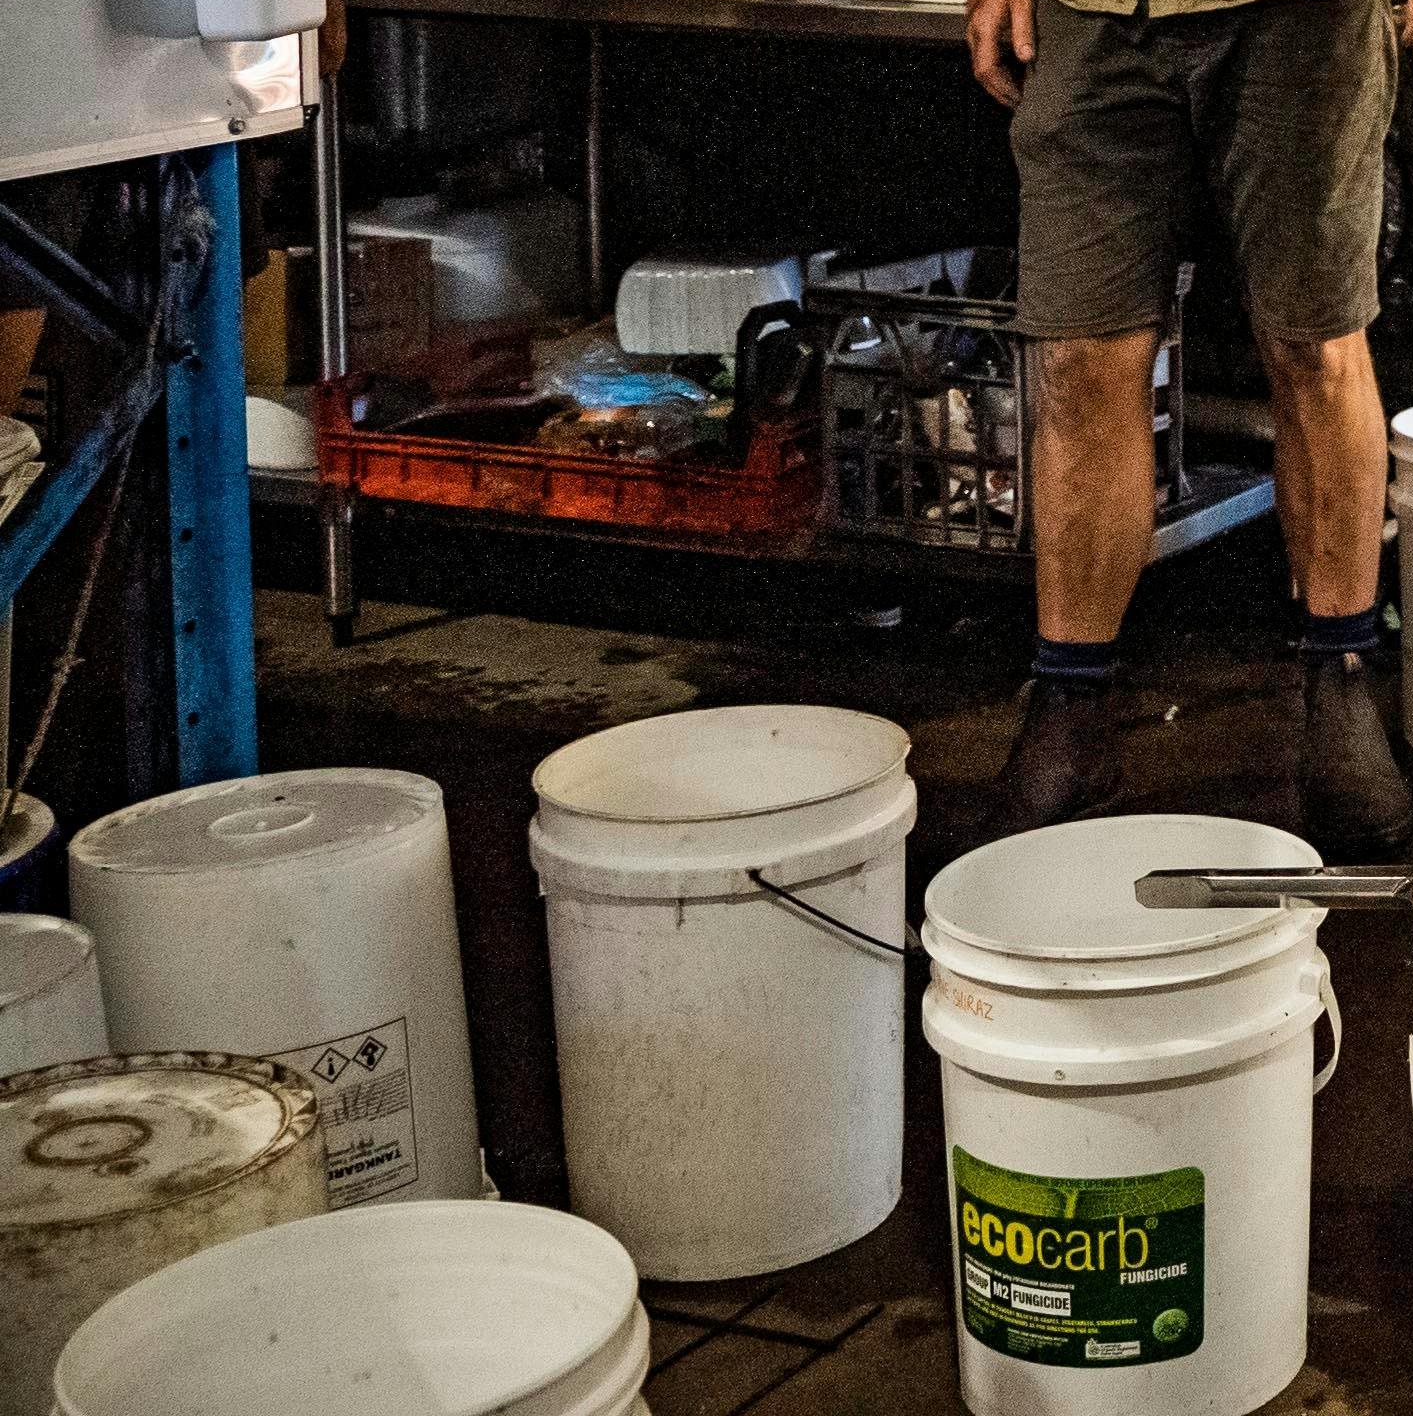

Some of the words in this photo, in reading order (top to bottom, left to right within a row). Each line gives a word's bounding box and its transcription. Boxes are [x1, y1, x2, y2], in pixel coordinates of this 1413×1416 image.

[953, 988, 995, 1021] SHIRAZ
[1120, 1262, 1188, 1286] FUNGICIDE
[993, 1281, 1010, 1301] M2
[1012, 1290, 1071, 1312] FUNGICIDE
